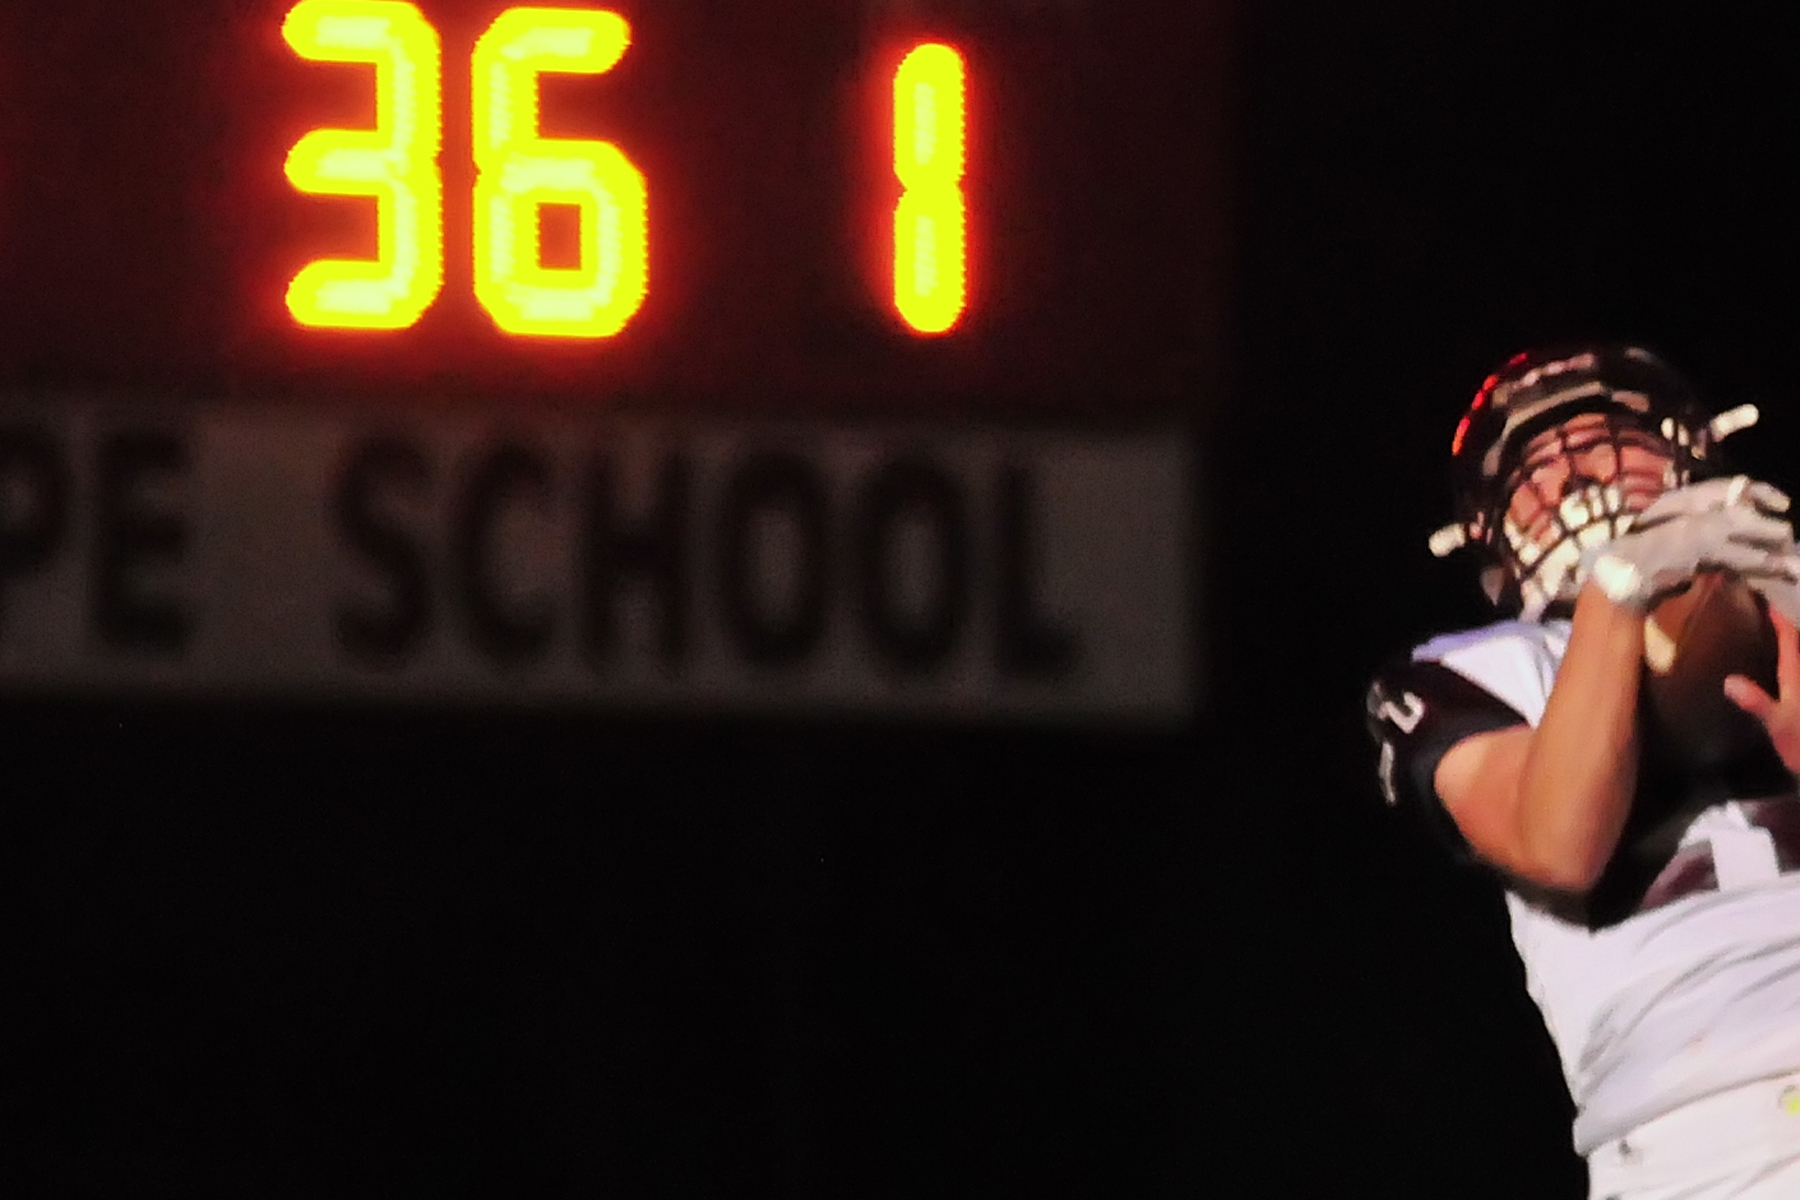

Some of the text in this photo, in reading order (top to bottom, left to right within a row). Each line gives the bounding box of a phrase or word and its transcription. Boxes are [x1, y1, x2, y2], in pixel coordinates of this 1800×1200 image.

[281, 0, 967, 337] 36 1
[330, 432, 1084, 680] SCHOOL
